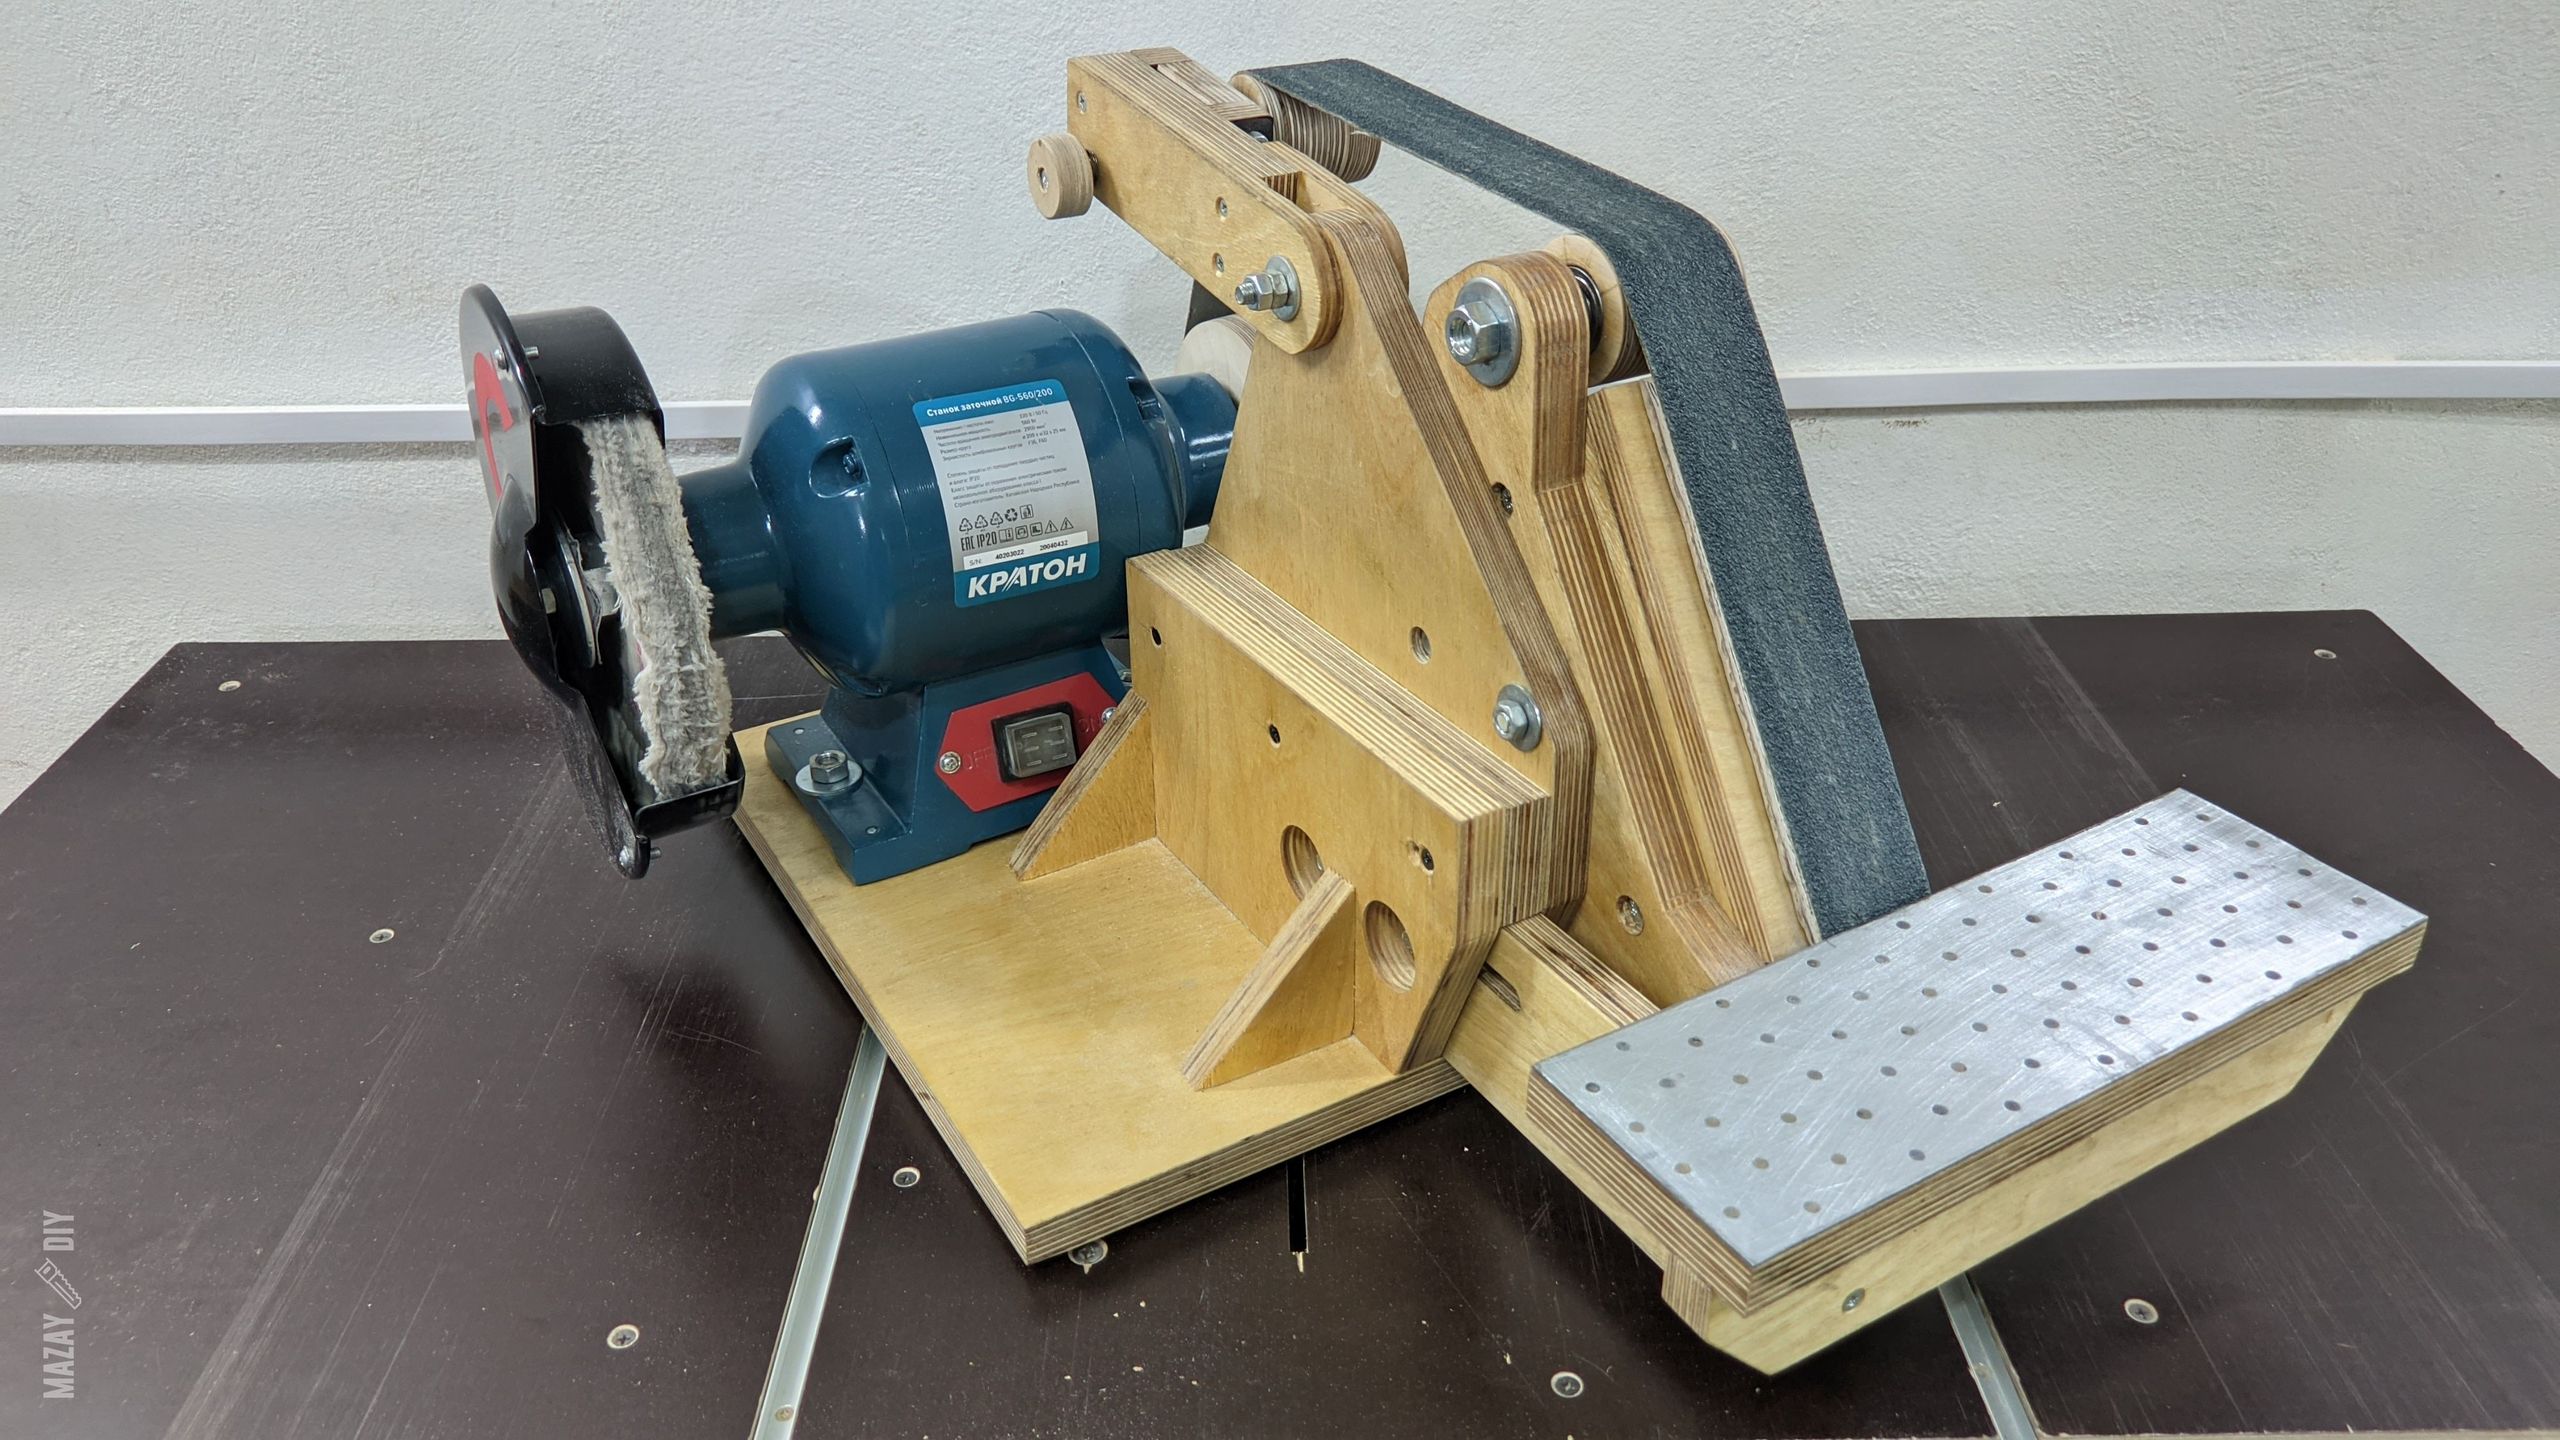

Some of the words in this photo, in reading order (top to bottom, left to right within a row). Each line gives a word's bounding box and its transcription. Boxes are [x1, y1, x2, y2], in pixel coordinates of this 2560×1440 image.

[926, 405, 960, 417] Станок
[961, 397, 1002, 412] заточной
[1003, 387, 1053, 404] BG-560/200
[976, 531, 997, 548] IP20
[968, 553, 1087, 599] КРАТОН
